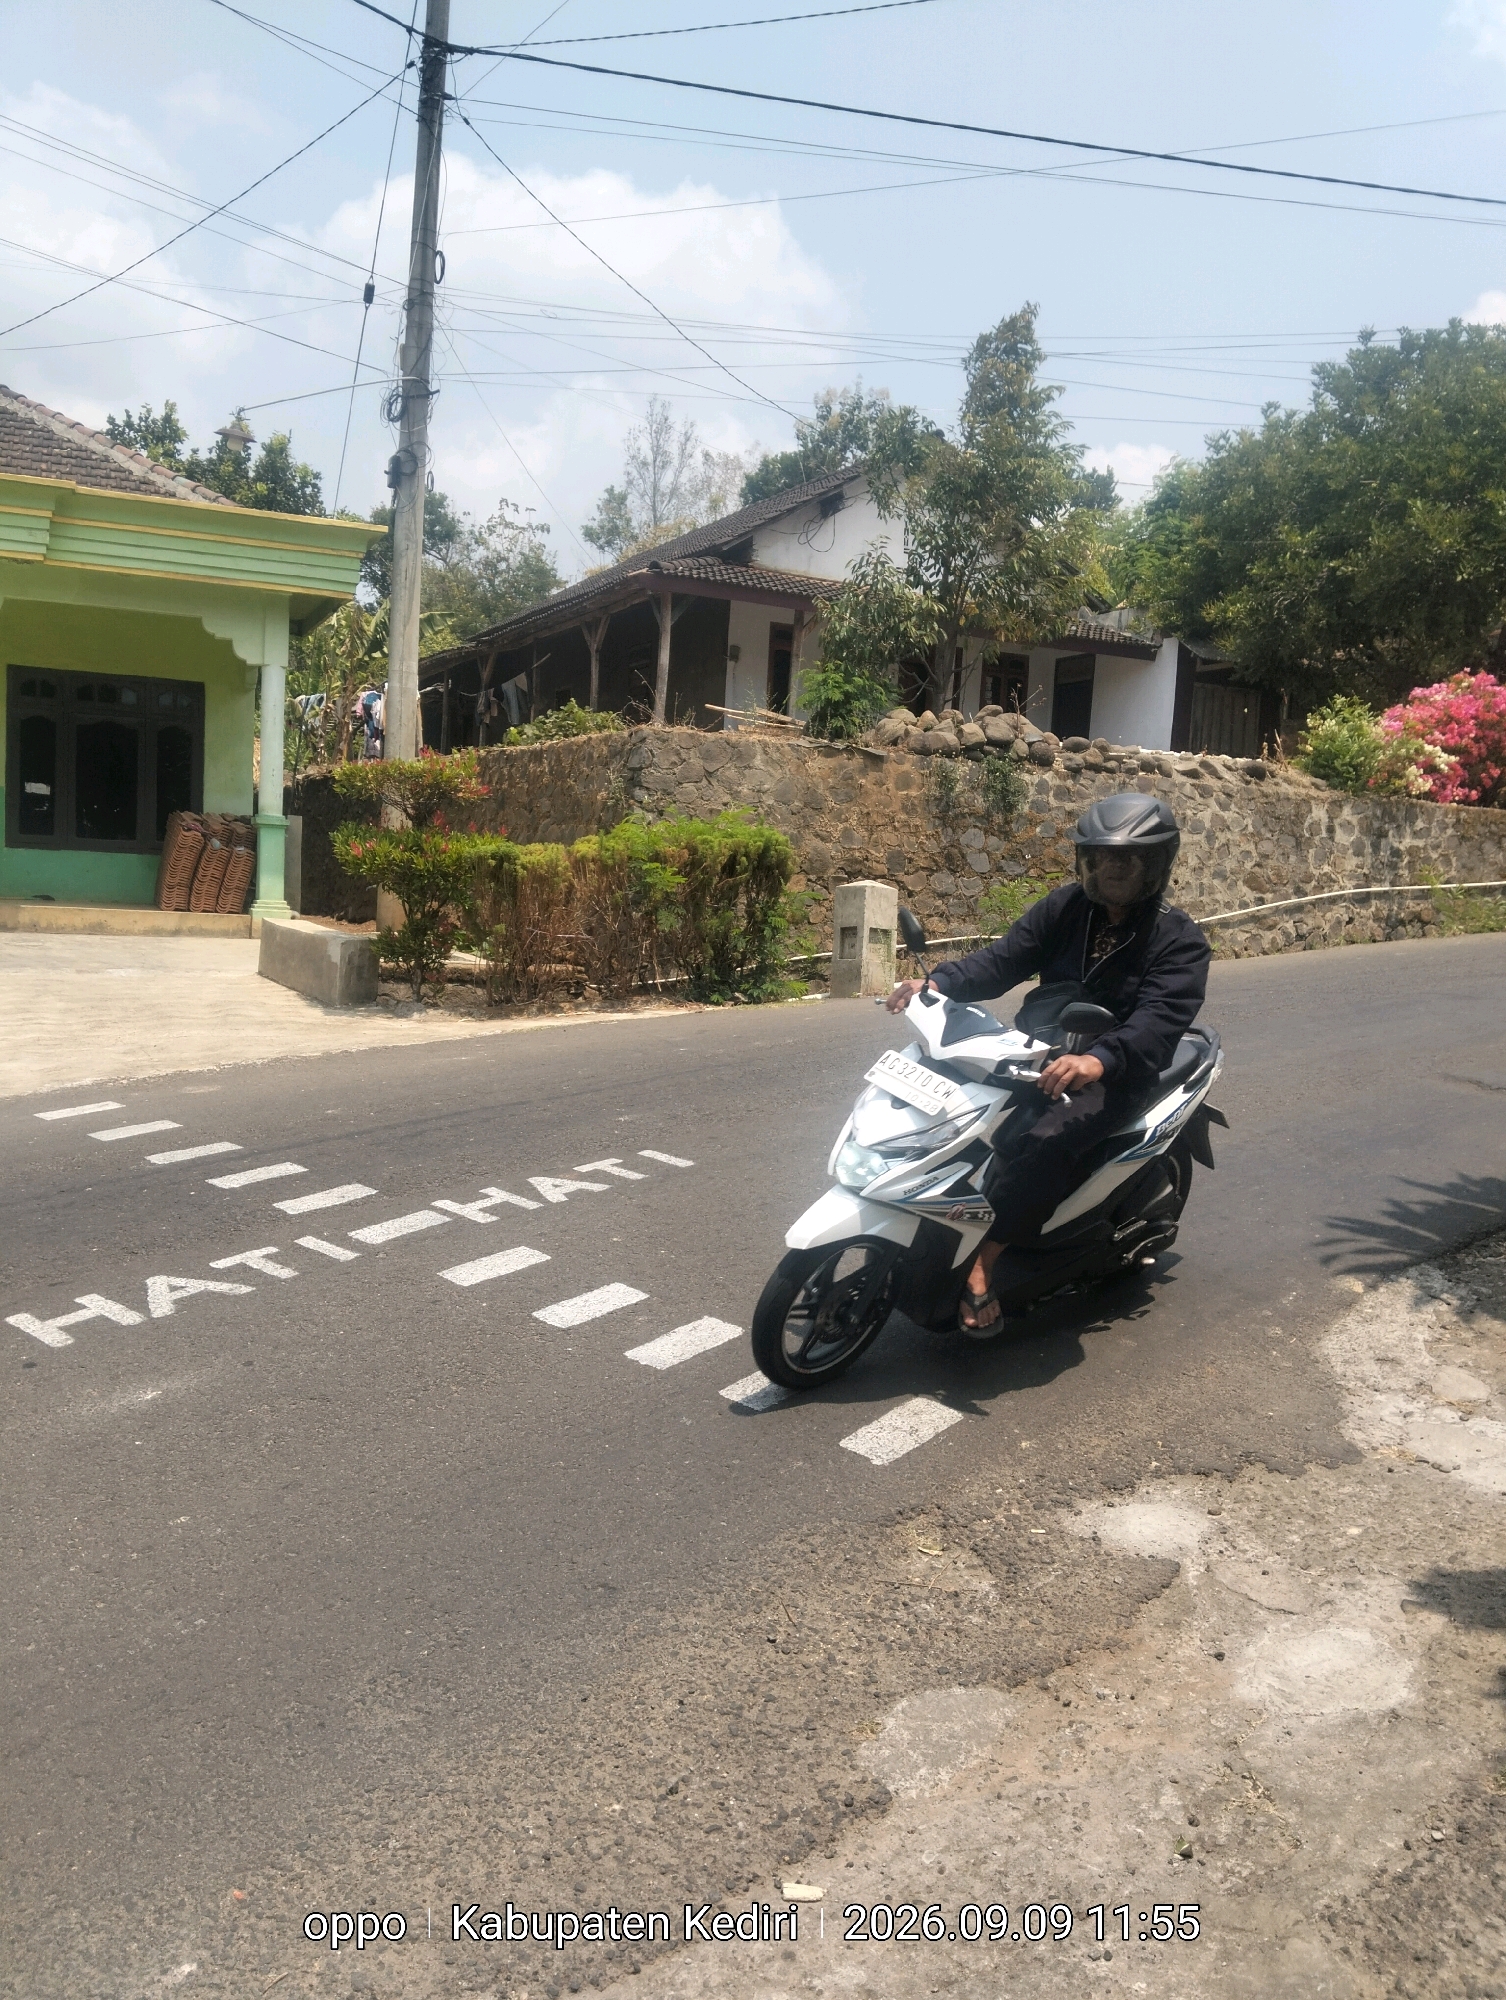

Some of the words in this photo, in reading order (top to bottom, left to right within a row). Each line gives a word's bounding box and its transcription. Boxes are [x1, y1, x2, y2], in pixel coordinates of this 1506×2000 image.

[879, 1053, 901, 1070] AG
[897, 1062, 934, 1087] 3210
[933, 1081, 958, 1099] CW
[903, 1176, 940, 1196] HONDA
